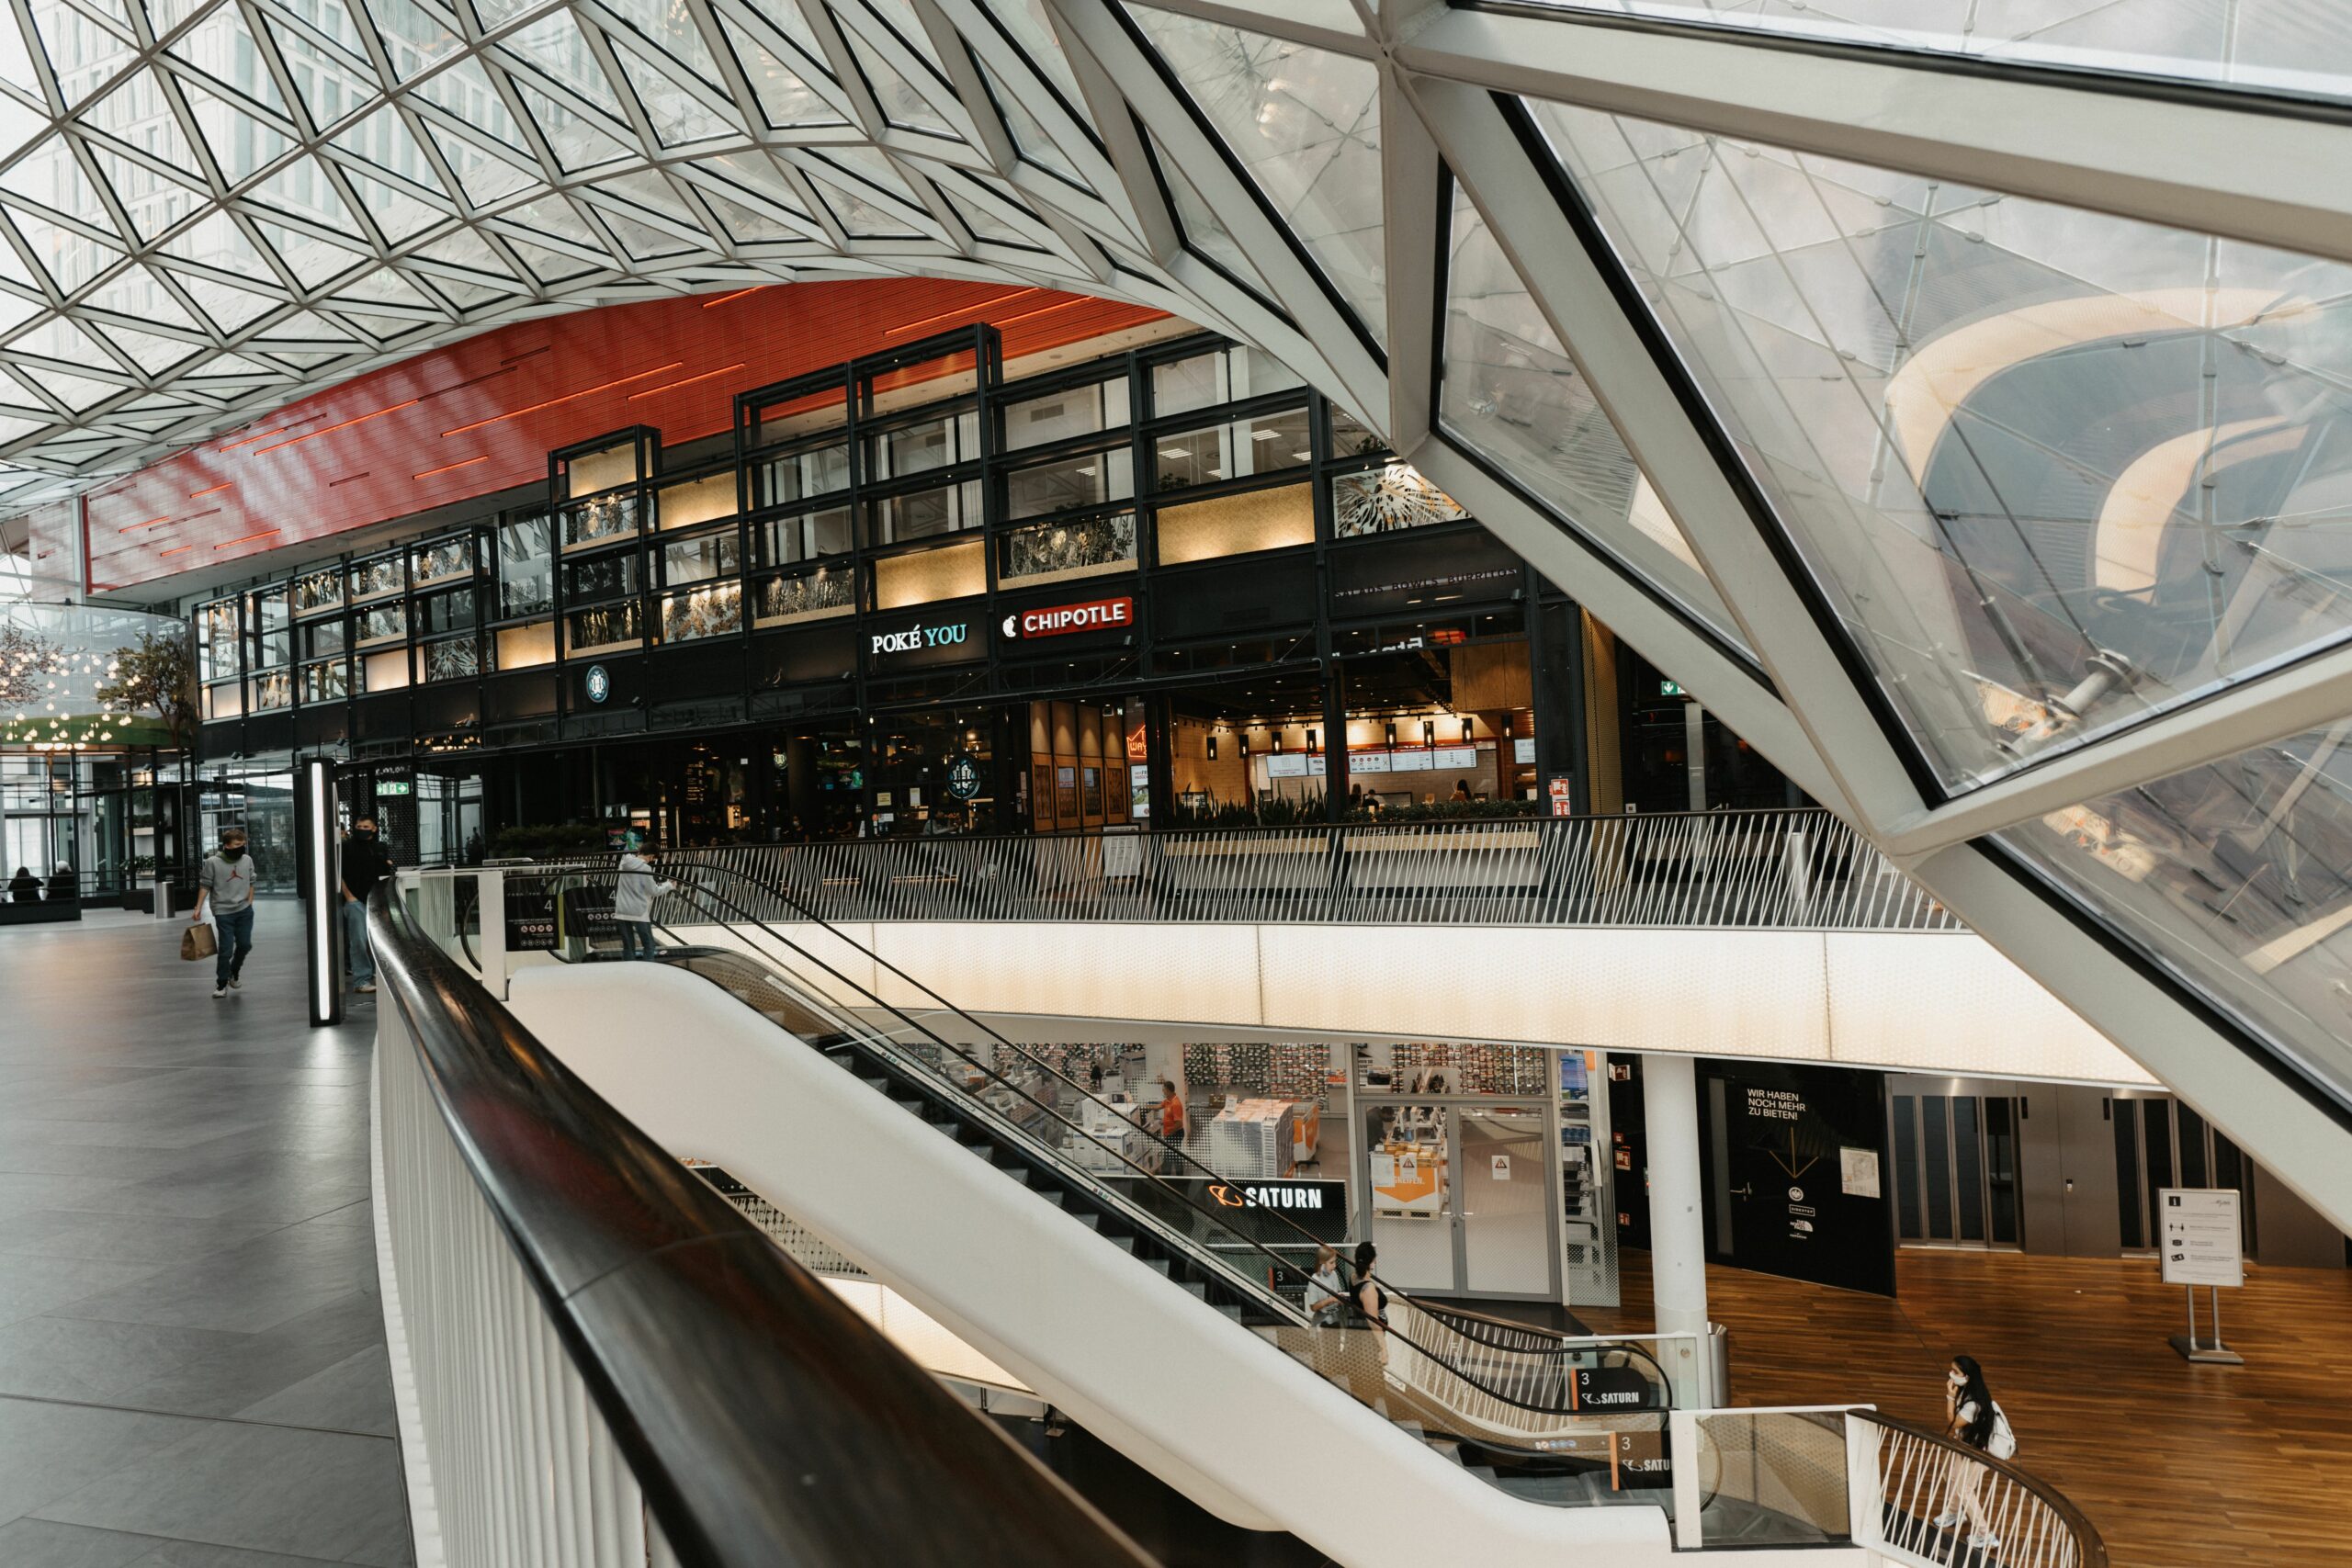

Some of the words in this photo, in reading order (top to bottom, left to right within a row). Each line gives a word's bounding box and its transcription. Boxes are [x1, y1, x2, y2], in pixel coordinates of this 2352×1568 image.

[1334, 586, 1384, 597] SALADS
[1391, 577, 1439, 591] BOWLS
[1447, 567, 1517, 584] BURRITOS
[1023, 603, 1126, 632] CHIPOTLE
[872, 624, 922, 653] POKÉ
[924, 624, 967, 647] YOU
[544, 899, 553, 912] 4
[1747, 1088, 1765, 1099] WIR
[1767, 1090, 1799, 1102] HABEN
[1747, 1098, 1776, 1109] NOCH
[1778, 1100, 1806, 1111] MEHR
[1748, 1106, 1761, 1116] ZU
[1763, 1108, 1798, 1121] BIETEN!
[1245, 1187, 1322, 1209] SATURN
[1276, 1271, 1283, 1281] 3
[1581, 1372, 1589, 1385] 3
[1600, 1392, 1640, 1404] SATURN
[1622, 1437, 1631, 1450] 3
[1644, 1459, 1670, 1471] SATU
